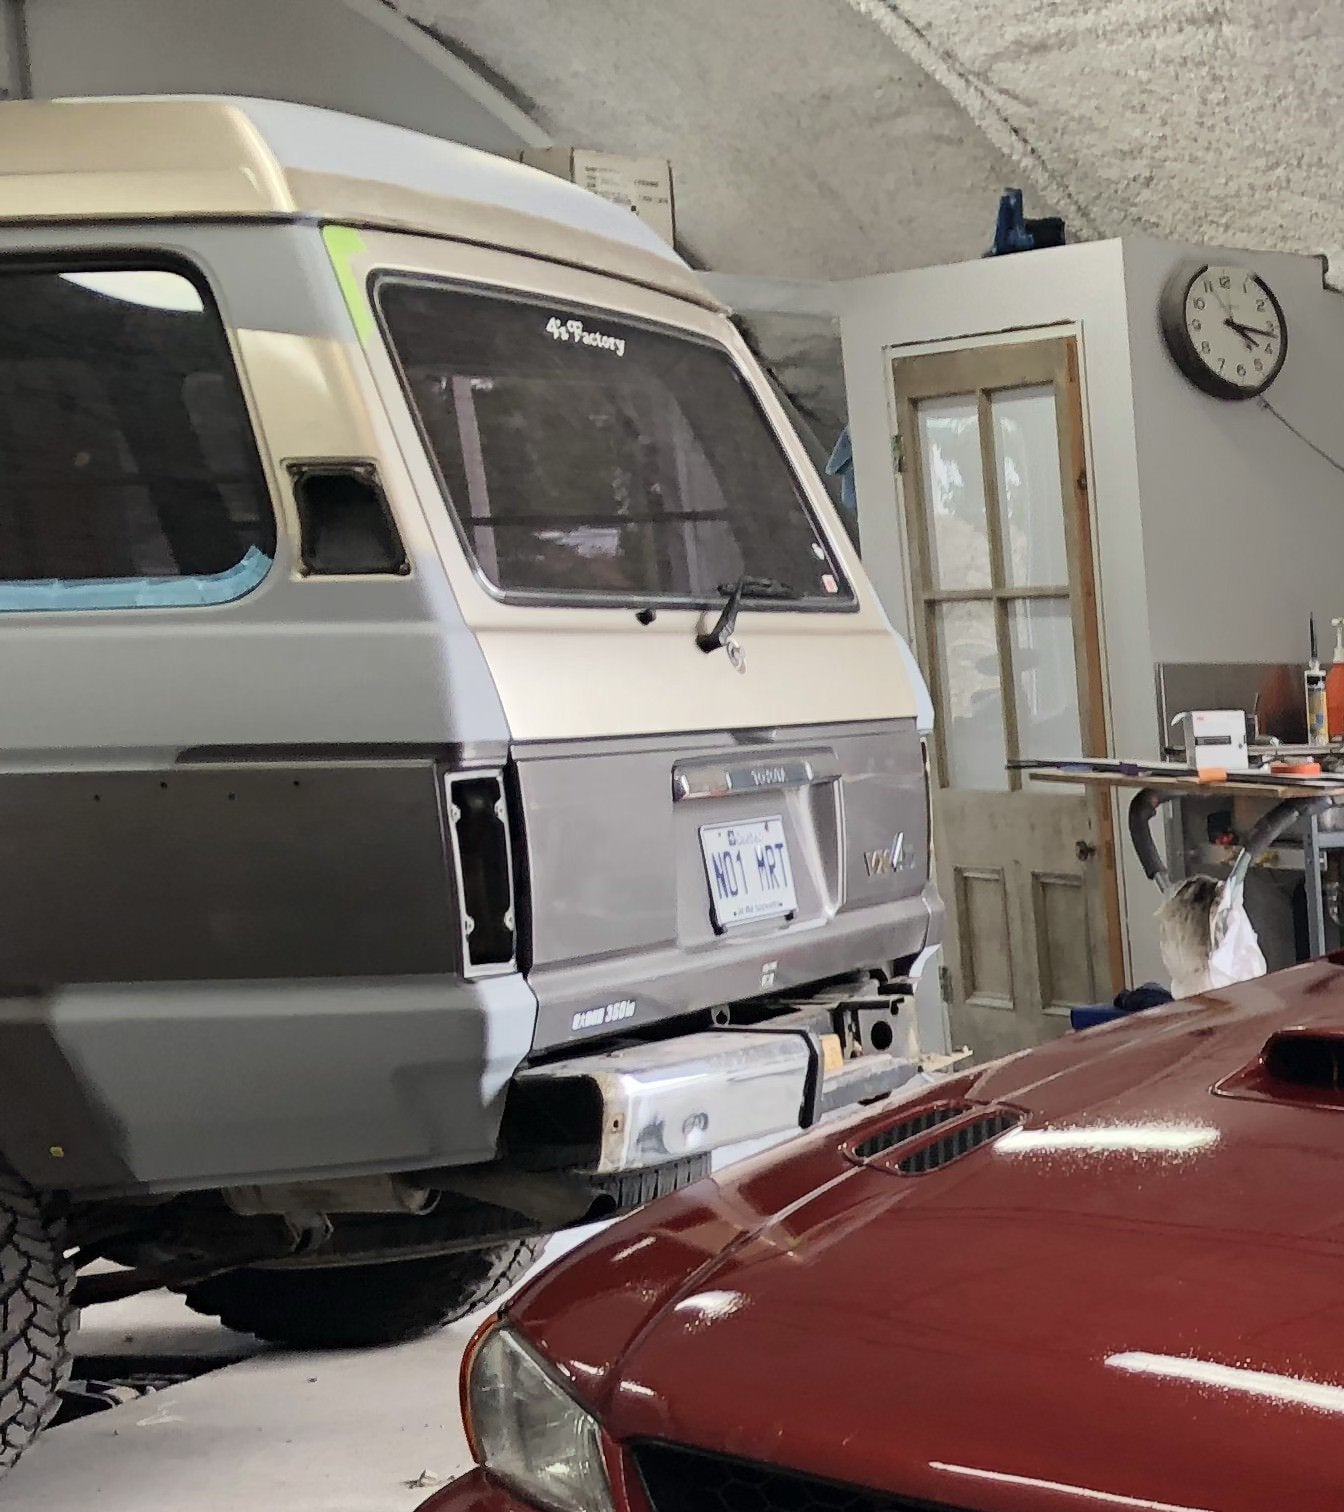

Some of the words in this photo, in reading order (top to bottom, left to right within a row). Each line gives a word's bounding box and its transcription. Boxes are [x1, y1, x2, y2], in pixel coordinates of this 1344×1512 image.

[1203, 280, 1213, 293] 11
[1256, 299, 1266, 312] 2
[755, 843, 788, 891] MRT
